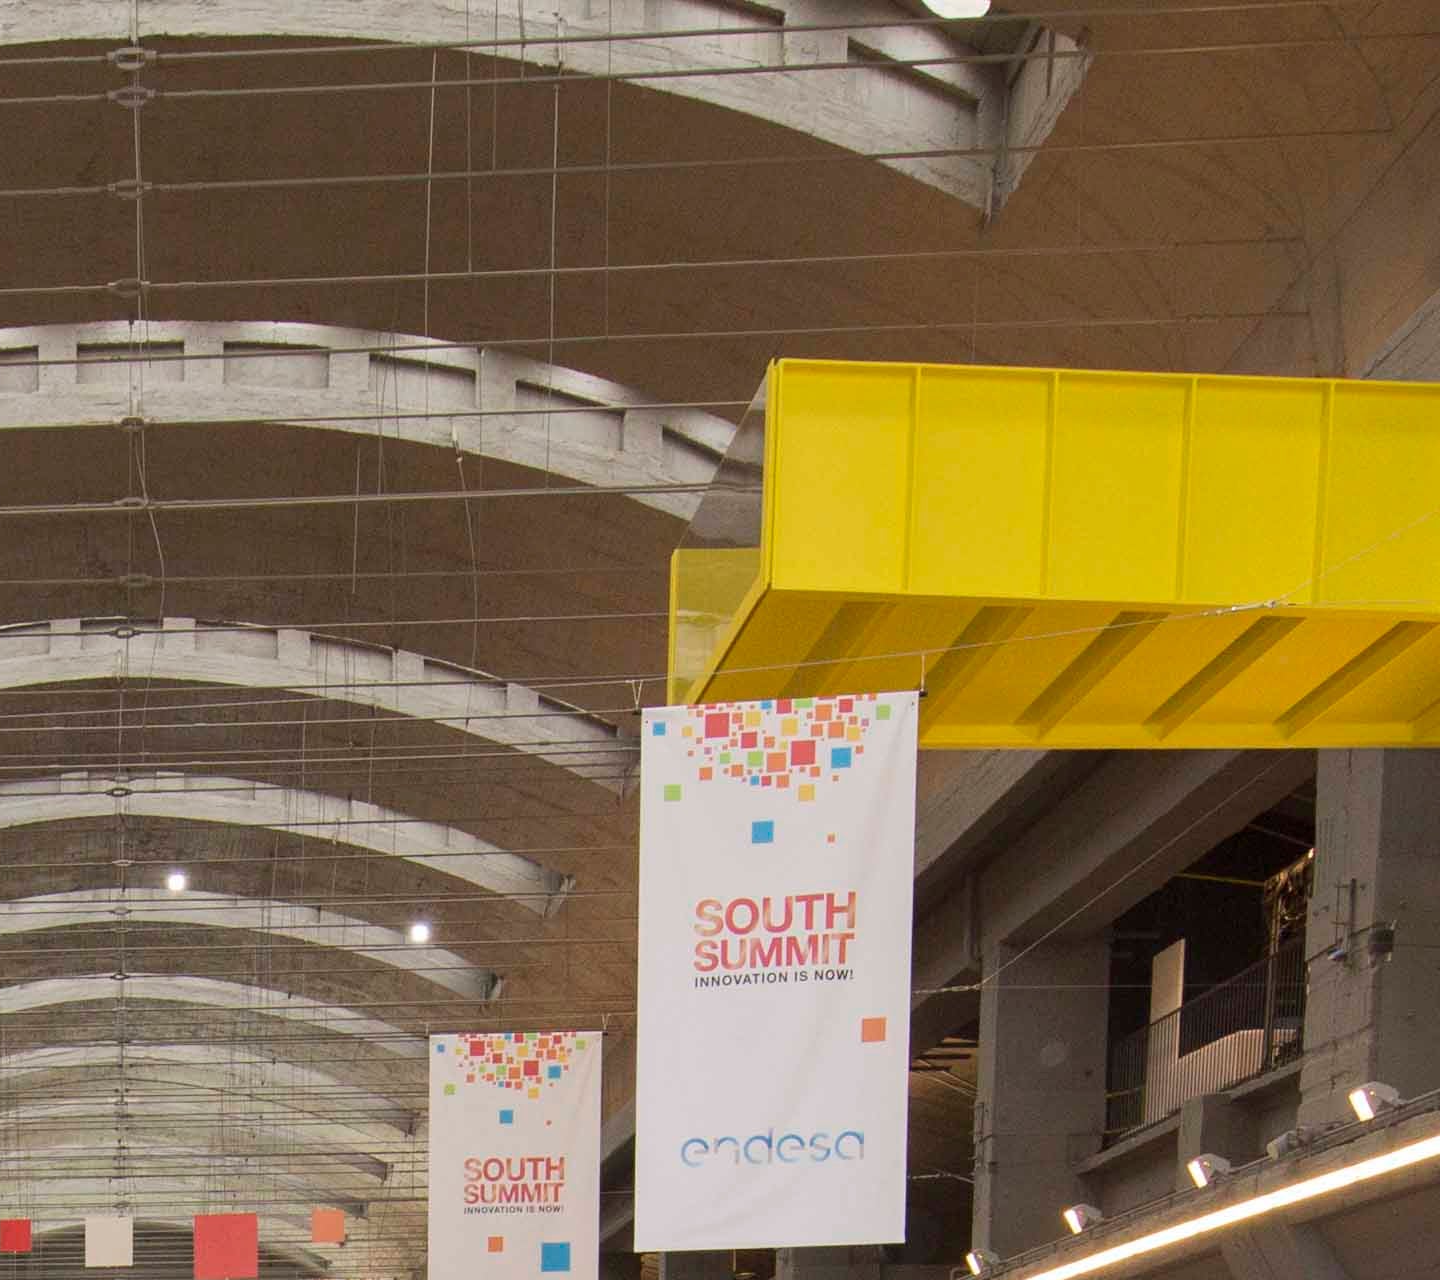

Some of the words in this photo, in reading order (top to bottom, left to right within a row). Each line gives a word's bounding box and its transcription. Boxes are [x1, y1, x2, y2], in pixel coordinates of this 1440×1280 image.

[694, 891, 857, 936] SOUTH
[693, 932, 855, 972] SUMMIT
[695, 972, 788, 988] INNOVATION
[794, 970, 809, 982] IS
[814, 969, 854, 981] NOW!
[680, 1127, 865, 1168] endesa
[464, 1157, 565, 1182] SOUTH
[464, 1183, 564, 1204] SUMMIT
